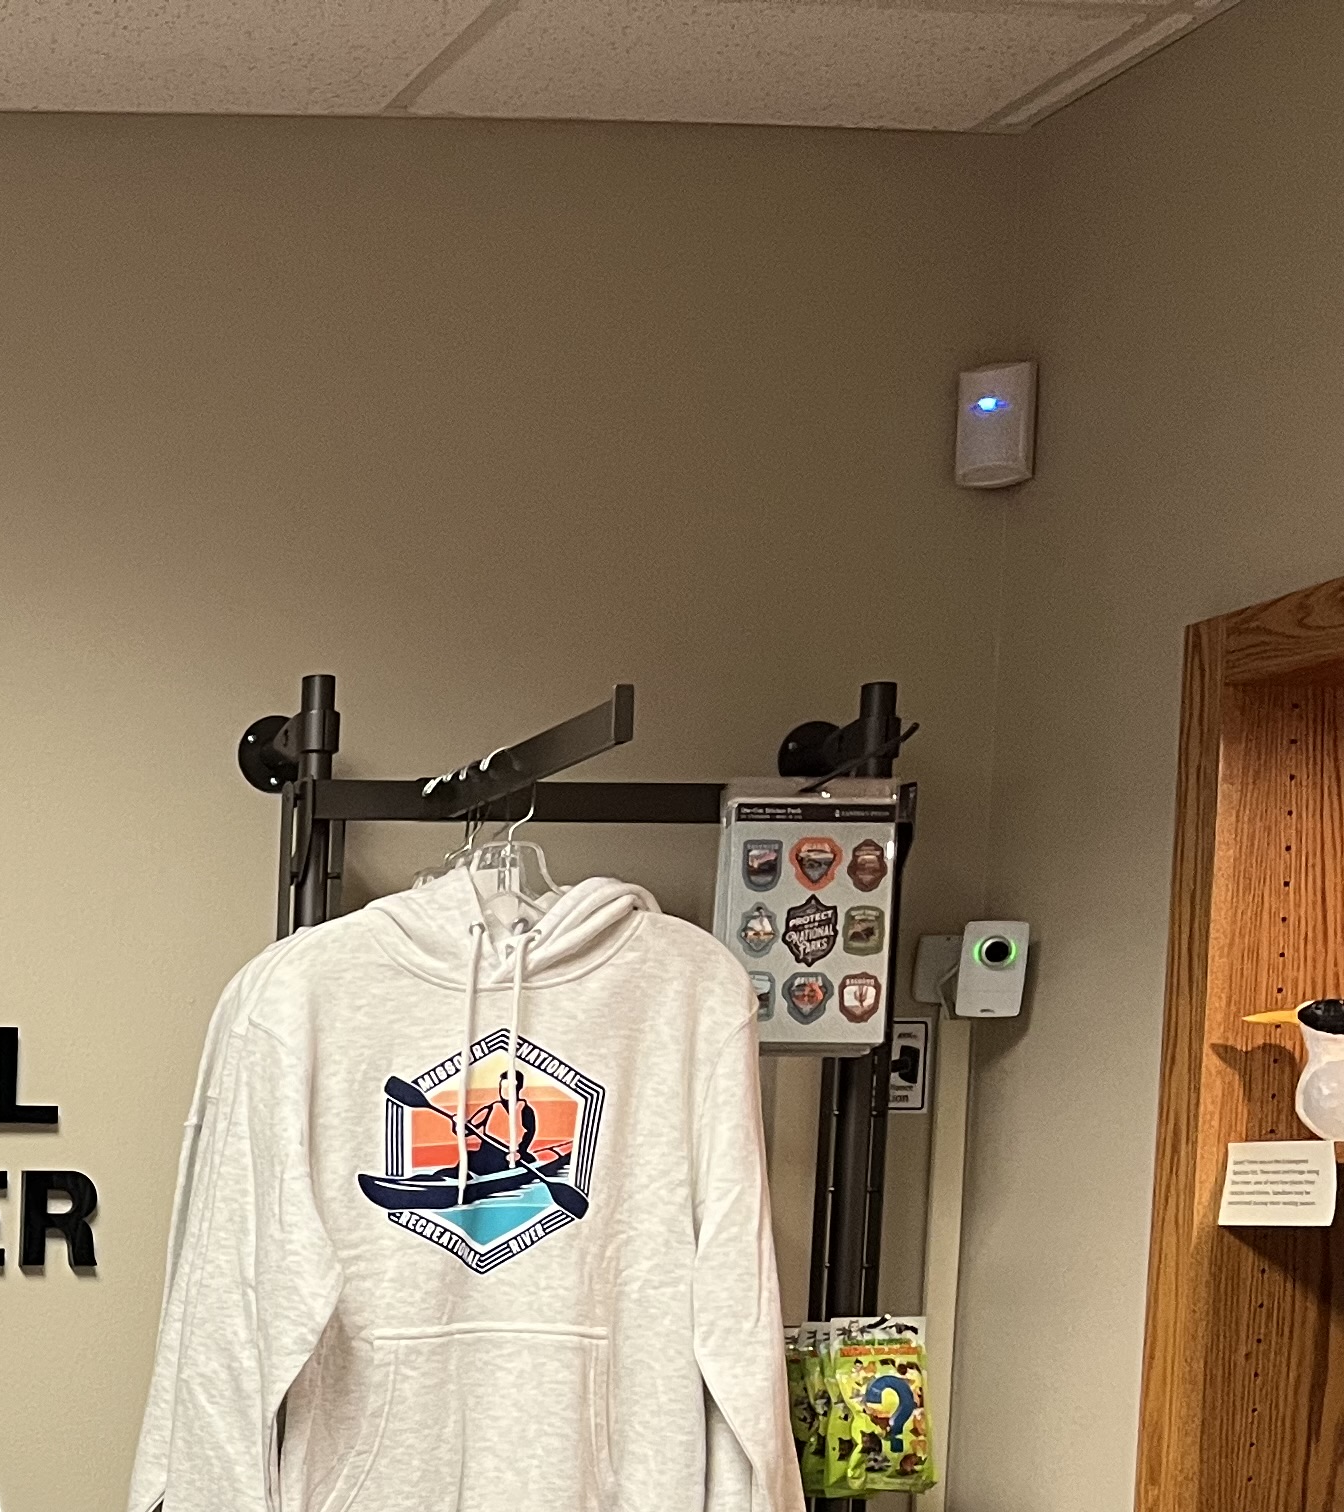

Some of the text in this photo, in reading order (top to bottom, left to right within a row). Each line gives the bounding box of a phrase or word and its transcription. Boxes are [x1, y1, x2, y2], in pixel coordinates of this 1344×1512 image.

[788, 910, 834, 929] PROTECT
[785, 922, 835, 945] NATIONAL
[796, 938, 829, 963] PARKS
[515, 1041, 581, 1091] NATIONAL
[398, 1209, 546, 1270] RECREATIONAL RIVER
